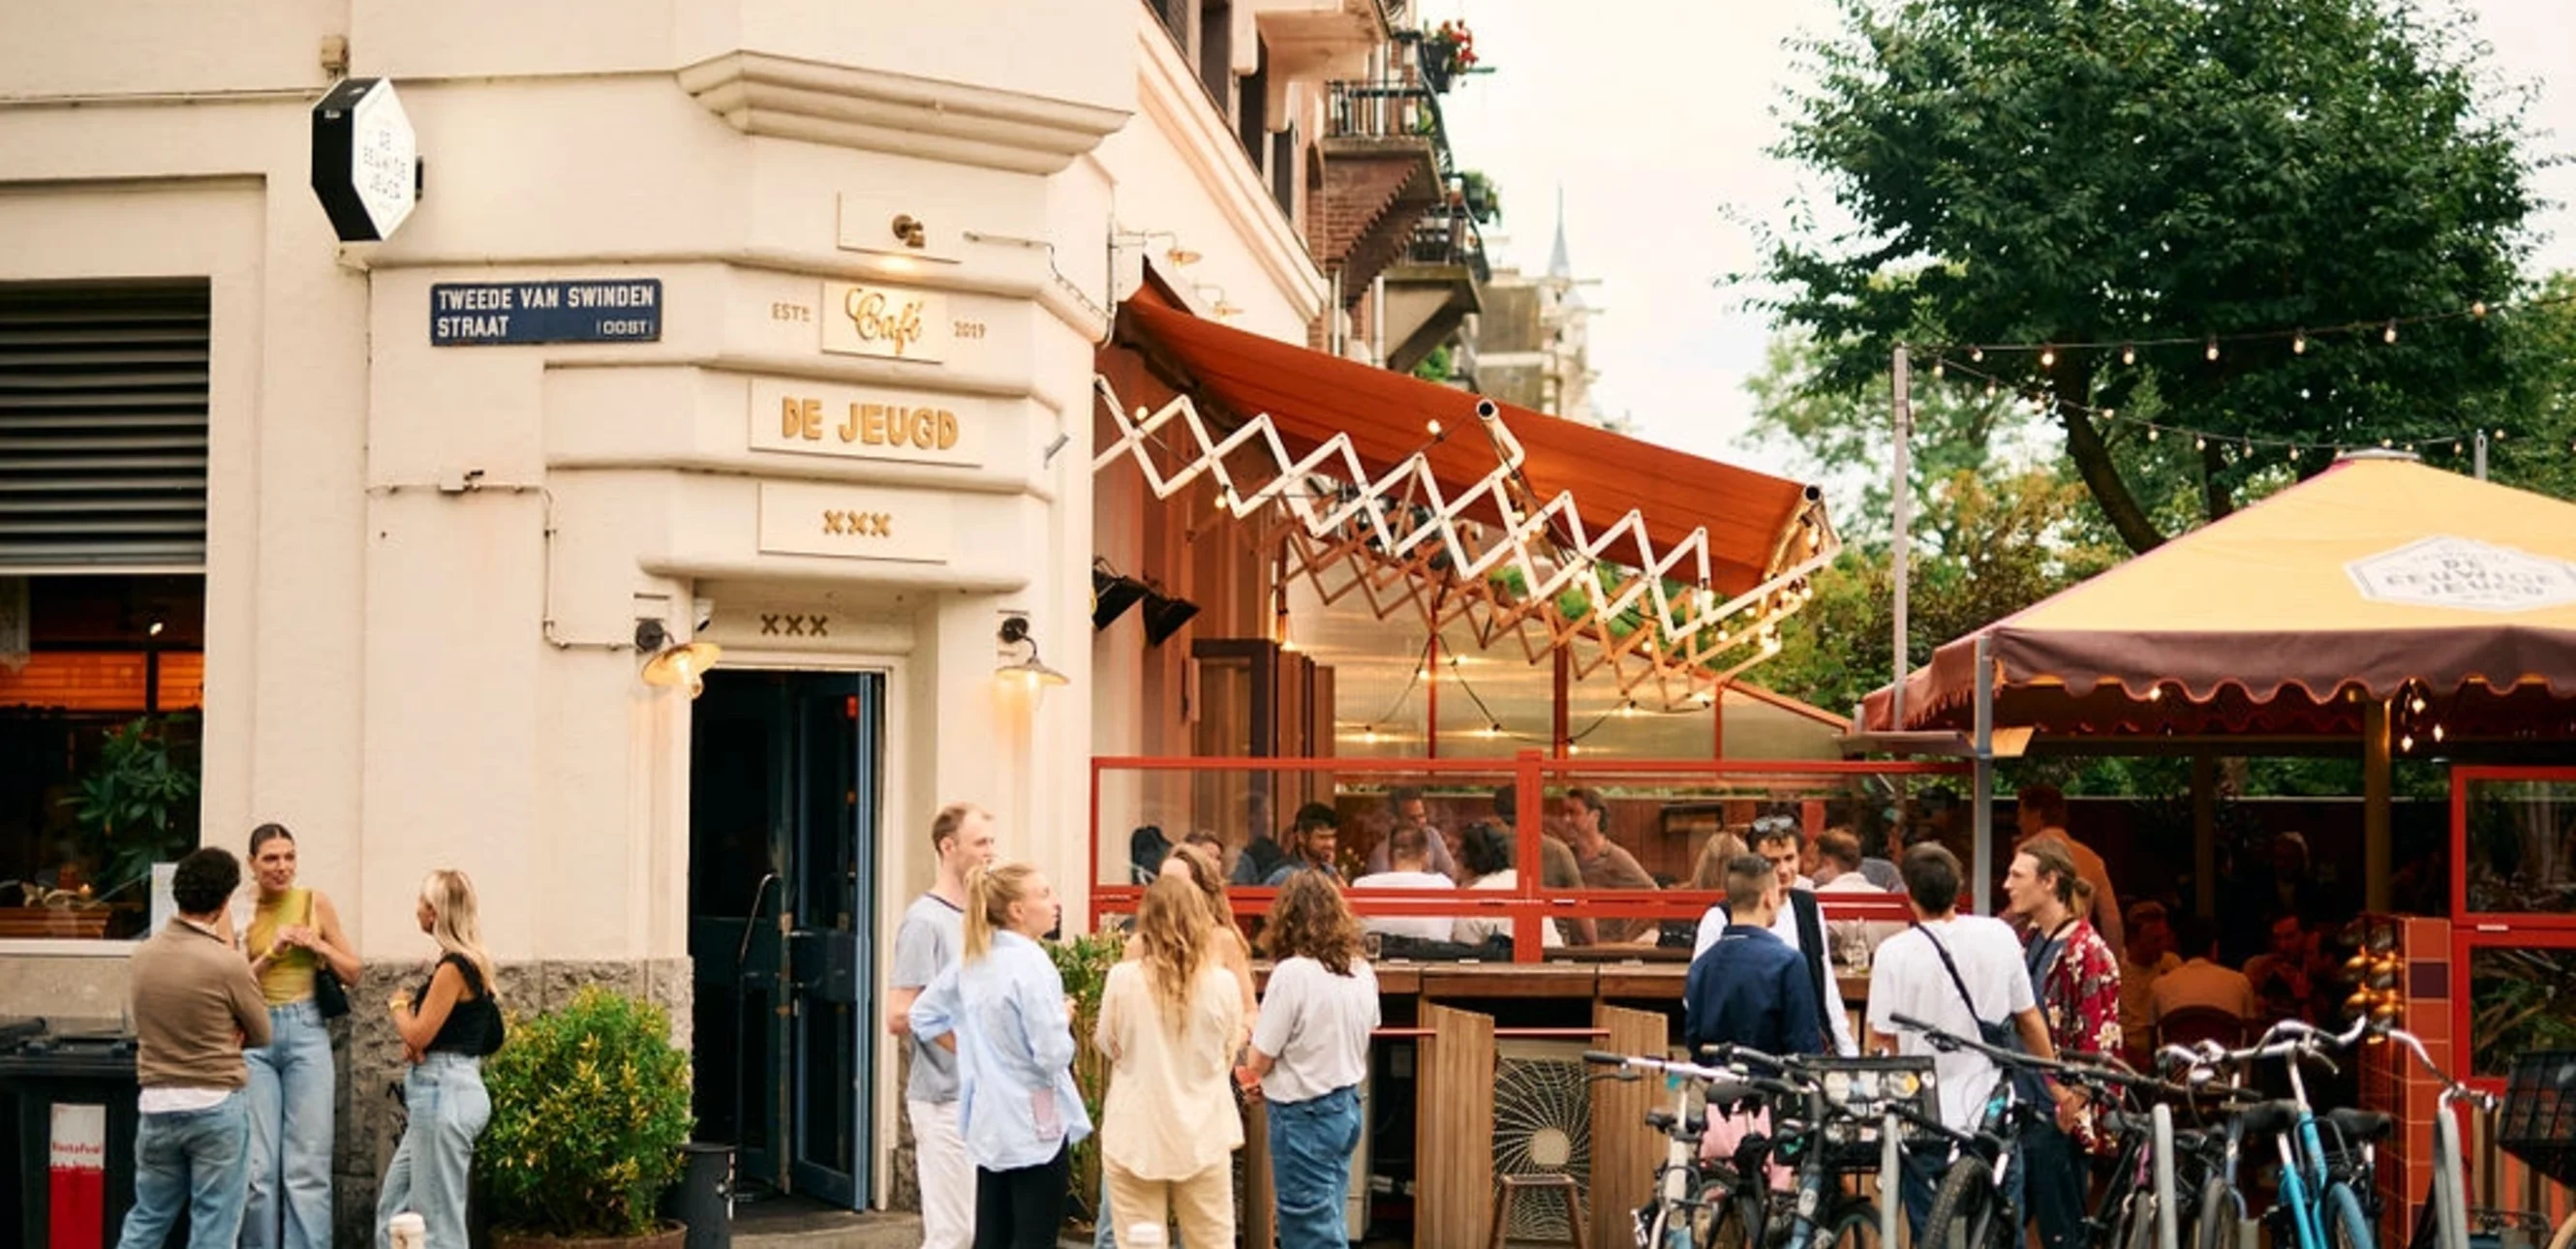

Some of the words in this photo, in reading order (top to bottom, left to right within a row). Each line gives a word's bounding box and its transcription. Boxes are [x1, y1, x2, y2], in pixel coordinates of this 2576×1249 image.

[438, 289, 513, 310] TWEEDE
[520, 288, 559, 309] VAN
[567, 286, 655, 308] SWINDEN
[437, 316, 509, 337] STRAAT
[844, 287, 924, 356] Café
[954, 320, 987, 340] 2019
[782, 396, 823, 442] DE
[838, 402, 960, 450] JEUGD
